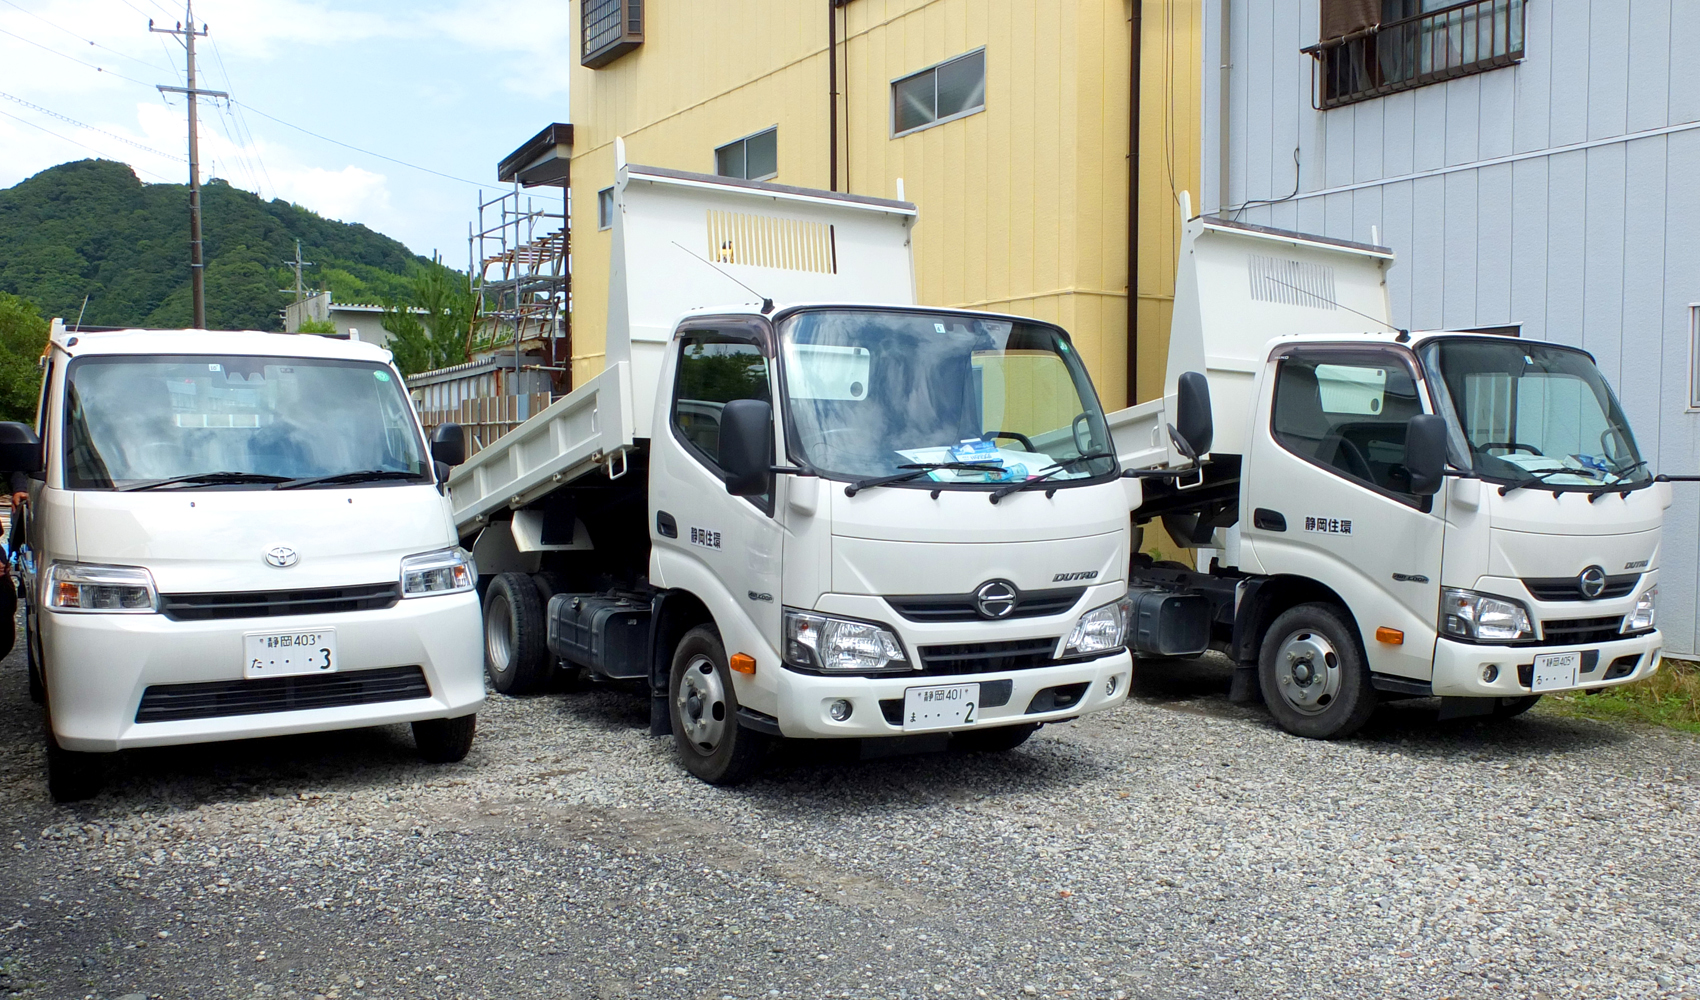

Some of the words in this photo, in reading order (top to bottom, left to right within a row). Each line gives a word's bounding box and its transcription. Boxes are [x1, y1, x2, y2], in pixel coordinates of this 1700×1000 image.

[1305, 516, 1352, 535] 静岡住環
[691, 526, 721, 549] 静岡住環
[1052, 570, 1098, 582] DUTRO
